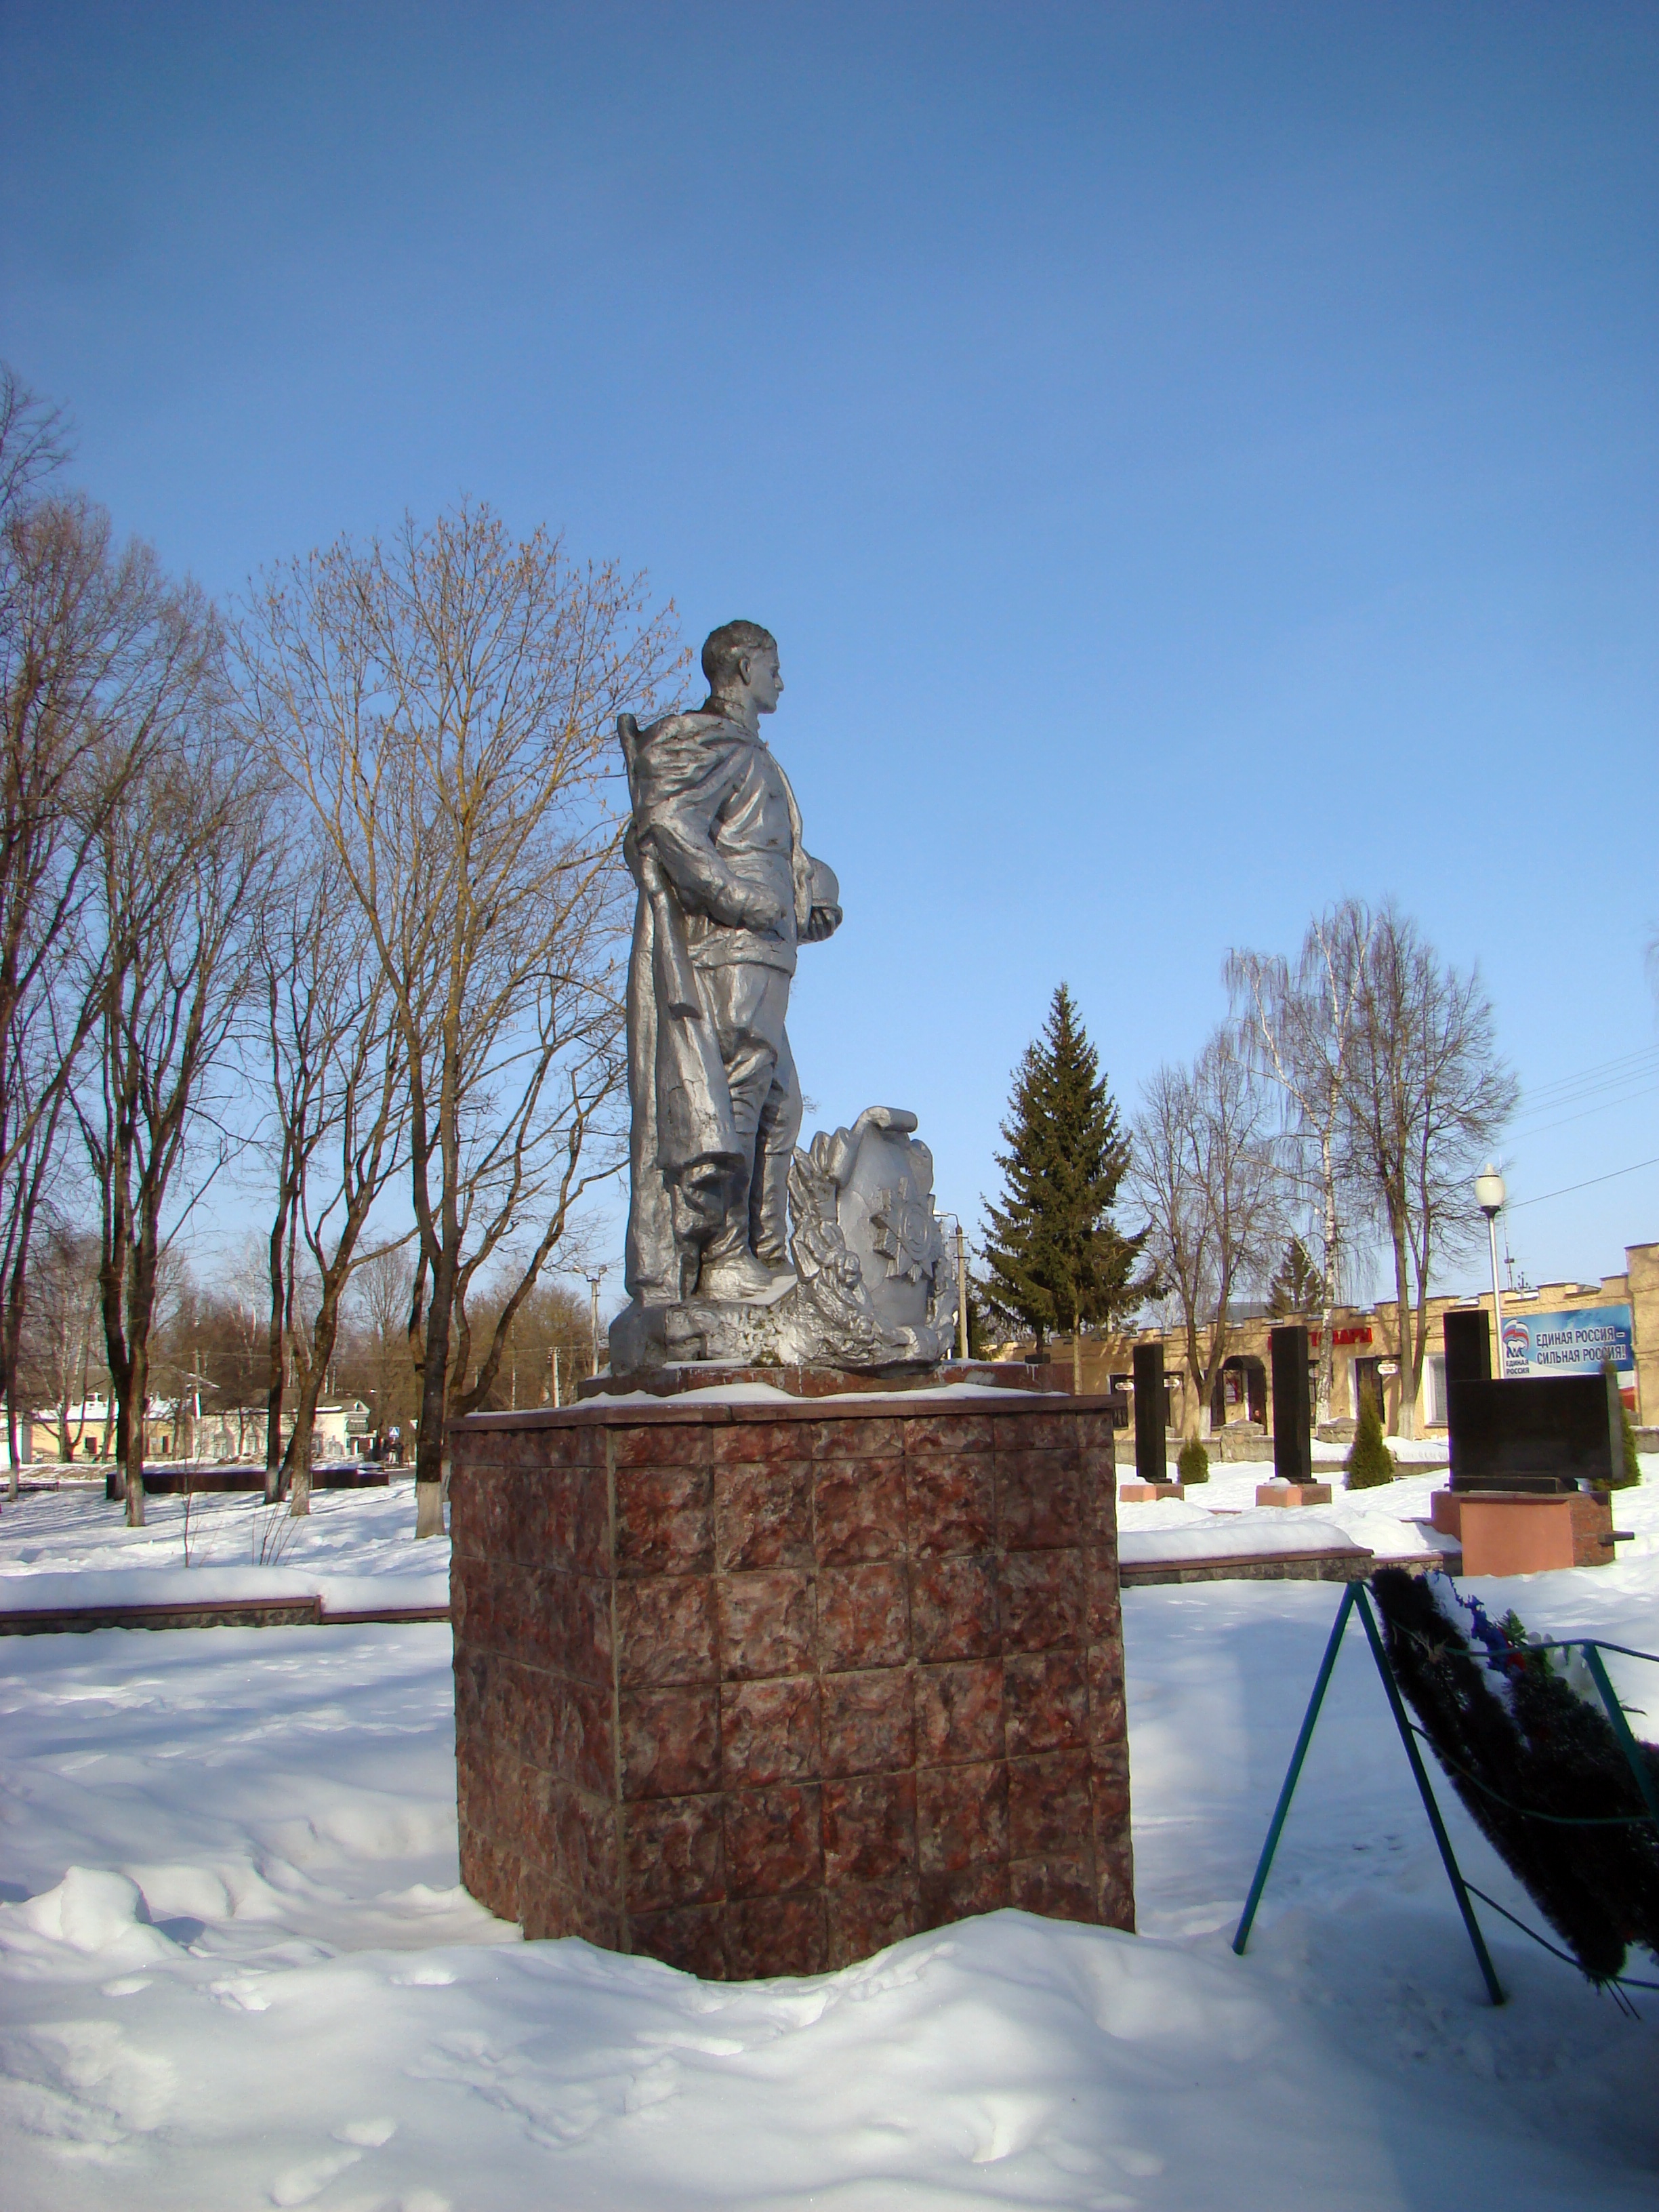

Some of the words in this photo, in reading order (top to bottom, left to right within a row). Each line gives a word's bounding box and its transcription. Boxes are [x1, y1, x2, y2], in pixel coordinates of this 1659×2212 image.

[1536, 1332, 1572, 1348] ЕДИНАЯ
[1576, 1328, 1614, 1343] РОССИЯ
[1537, 1349, 1580, 1365] СИЛЬНАЯ
[1583, 1346, 1626, 1361] РОССИЯ!
